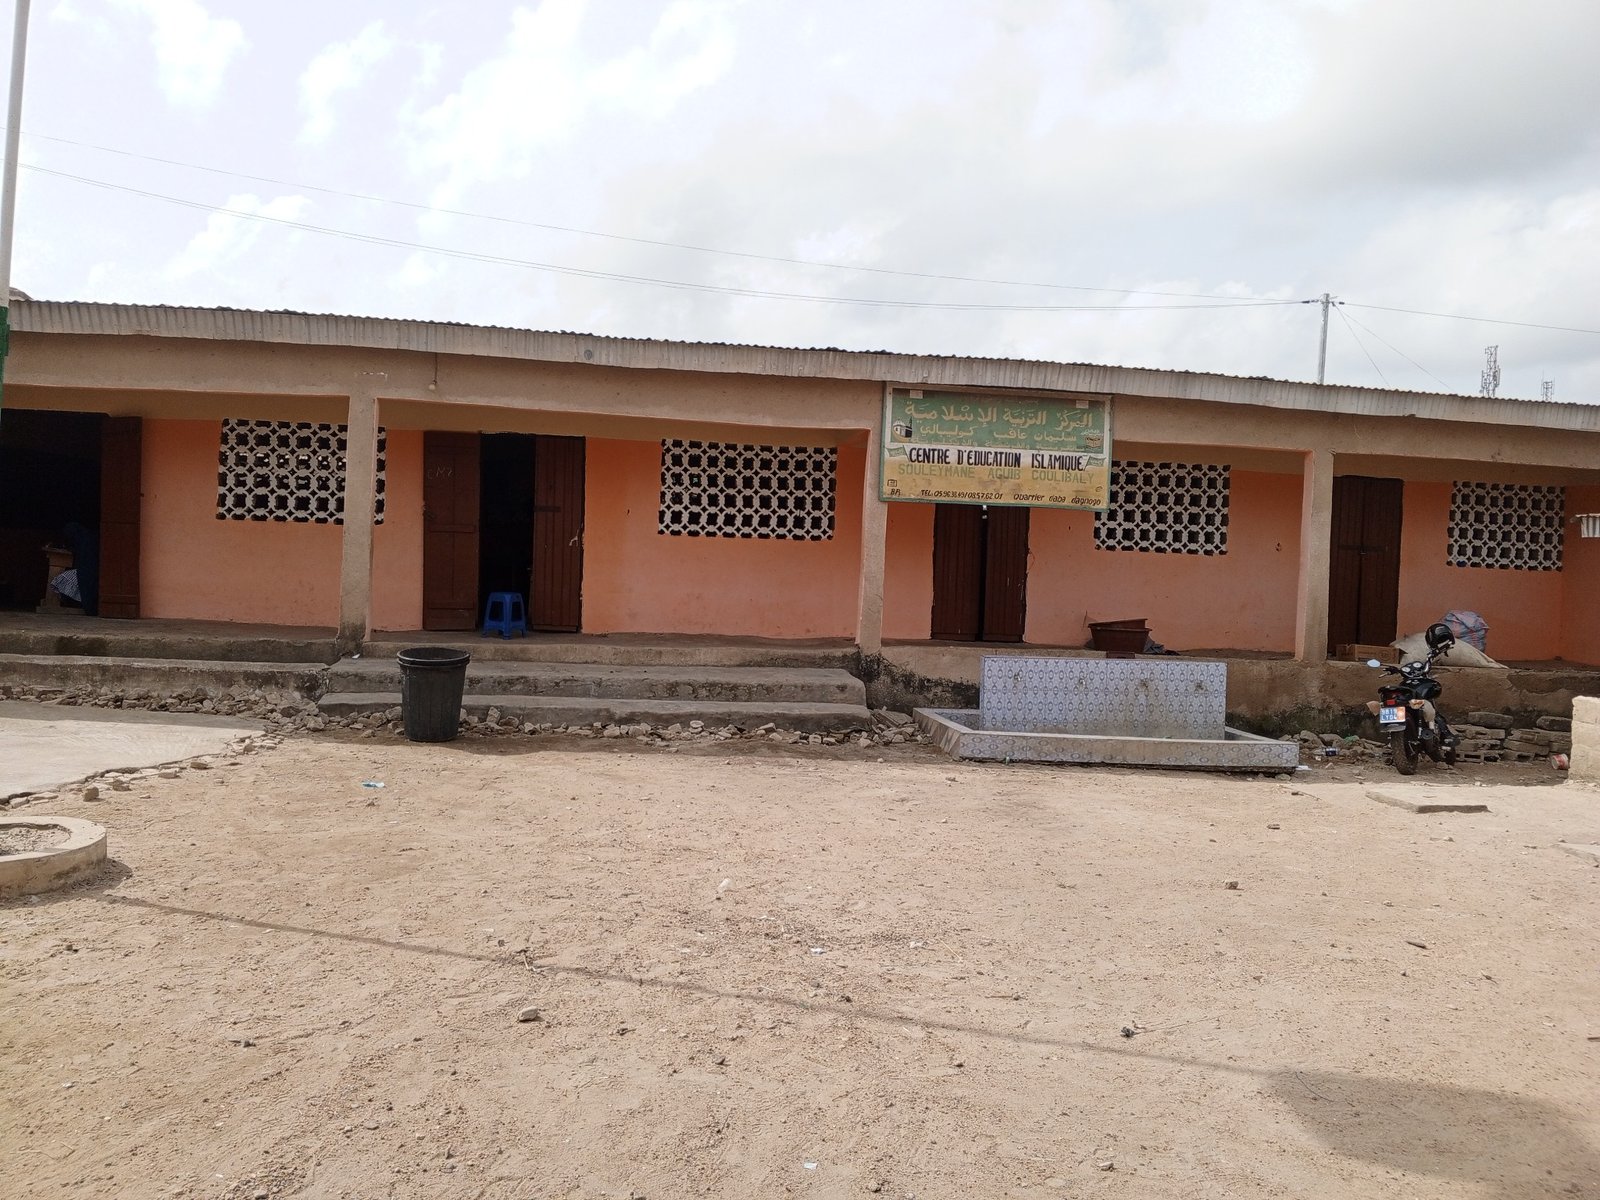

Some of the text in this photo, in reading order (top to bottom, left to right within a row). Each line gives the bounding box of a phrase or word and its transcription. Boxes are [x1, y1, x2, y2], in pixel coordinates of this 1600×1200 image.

[909, 447, 951, 464] CENTRE
[957, 449, 1022, 468] D'EDUCATION
[1031, 453, 1085, 472] ISLAMIQUE
[898, 463, 976, 479] SOULEYMANE
[1031, 469, 1095, 484] COULIBALY
